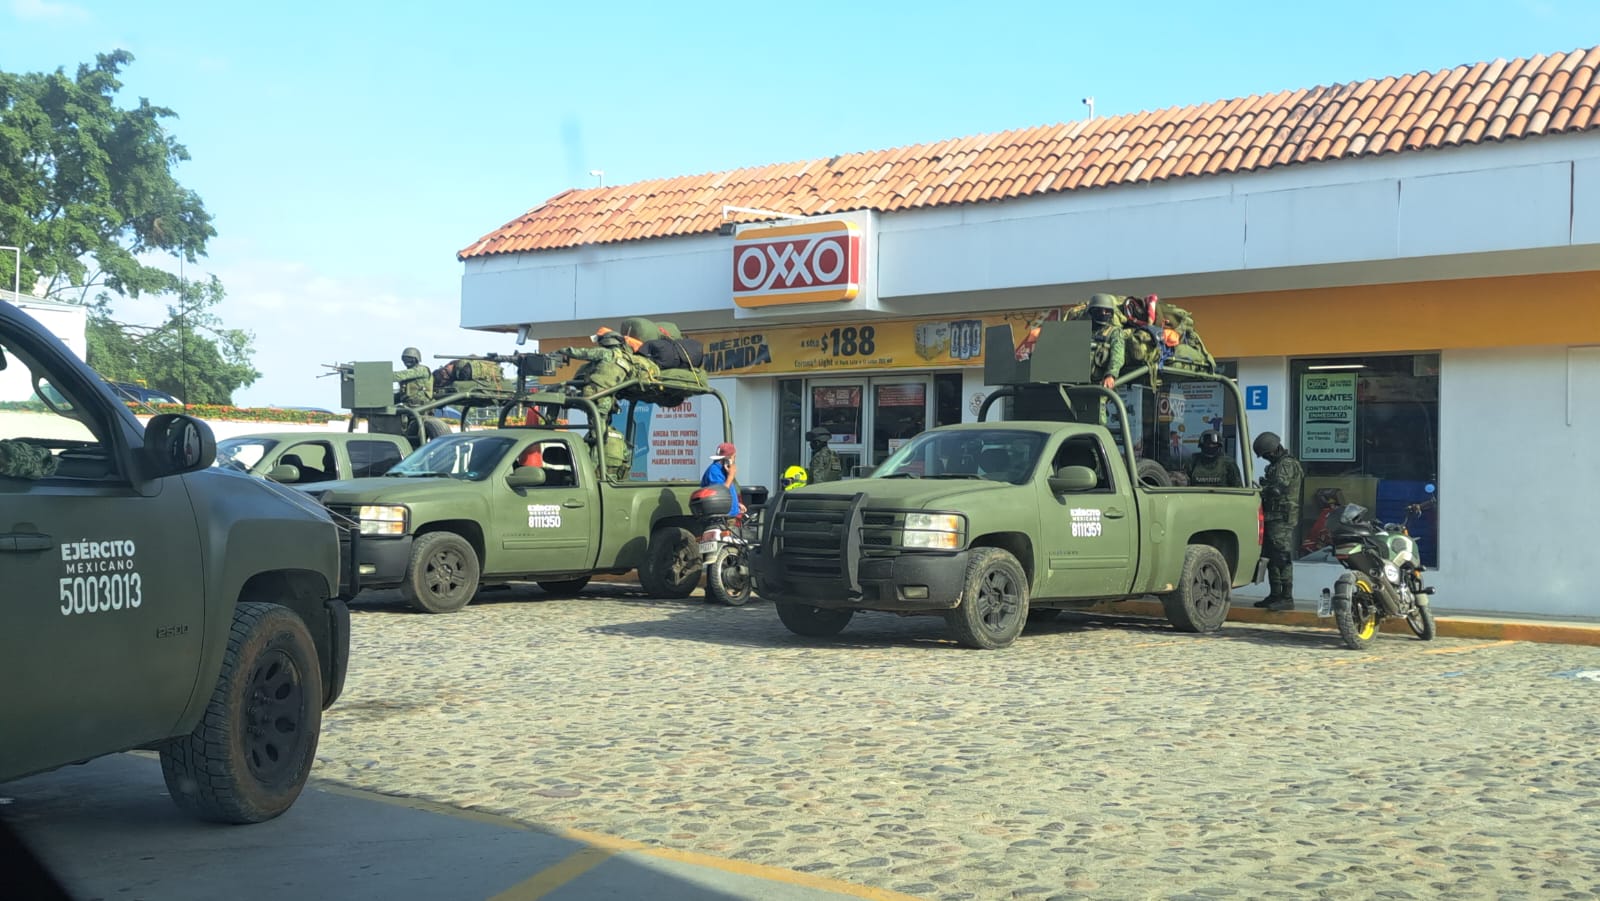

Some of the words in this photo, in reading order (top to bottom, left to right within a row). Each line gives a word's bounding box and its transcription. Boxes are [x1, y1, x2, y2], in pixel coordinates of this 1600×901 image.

[738, 240, 845, 288] OXXO
[821, 326, 875, 357] $188
[1252, 390, 1262, 406] E
[1305, 393, 1353, 402] VACANTES
[528, 515, 562, 528] 8111350
[1071, 521, 1102, 537] 8111359
[60, 538, 136, 561] EJÉRCITO
[66, 559, 134, 575] MEXICANO
[59, 572, 142, 616] 5003013
